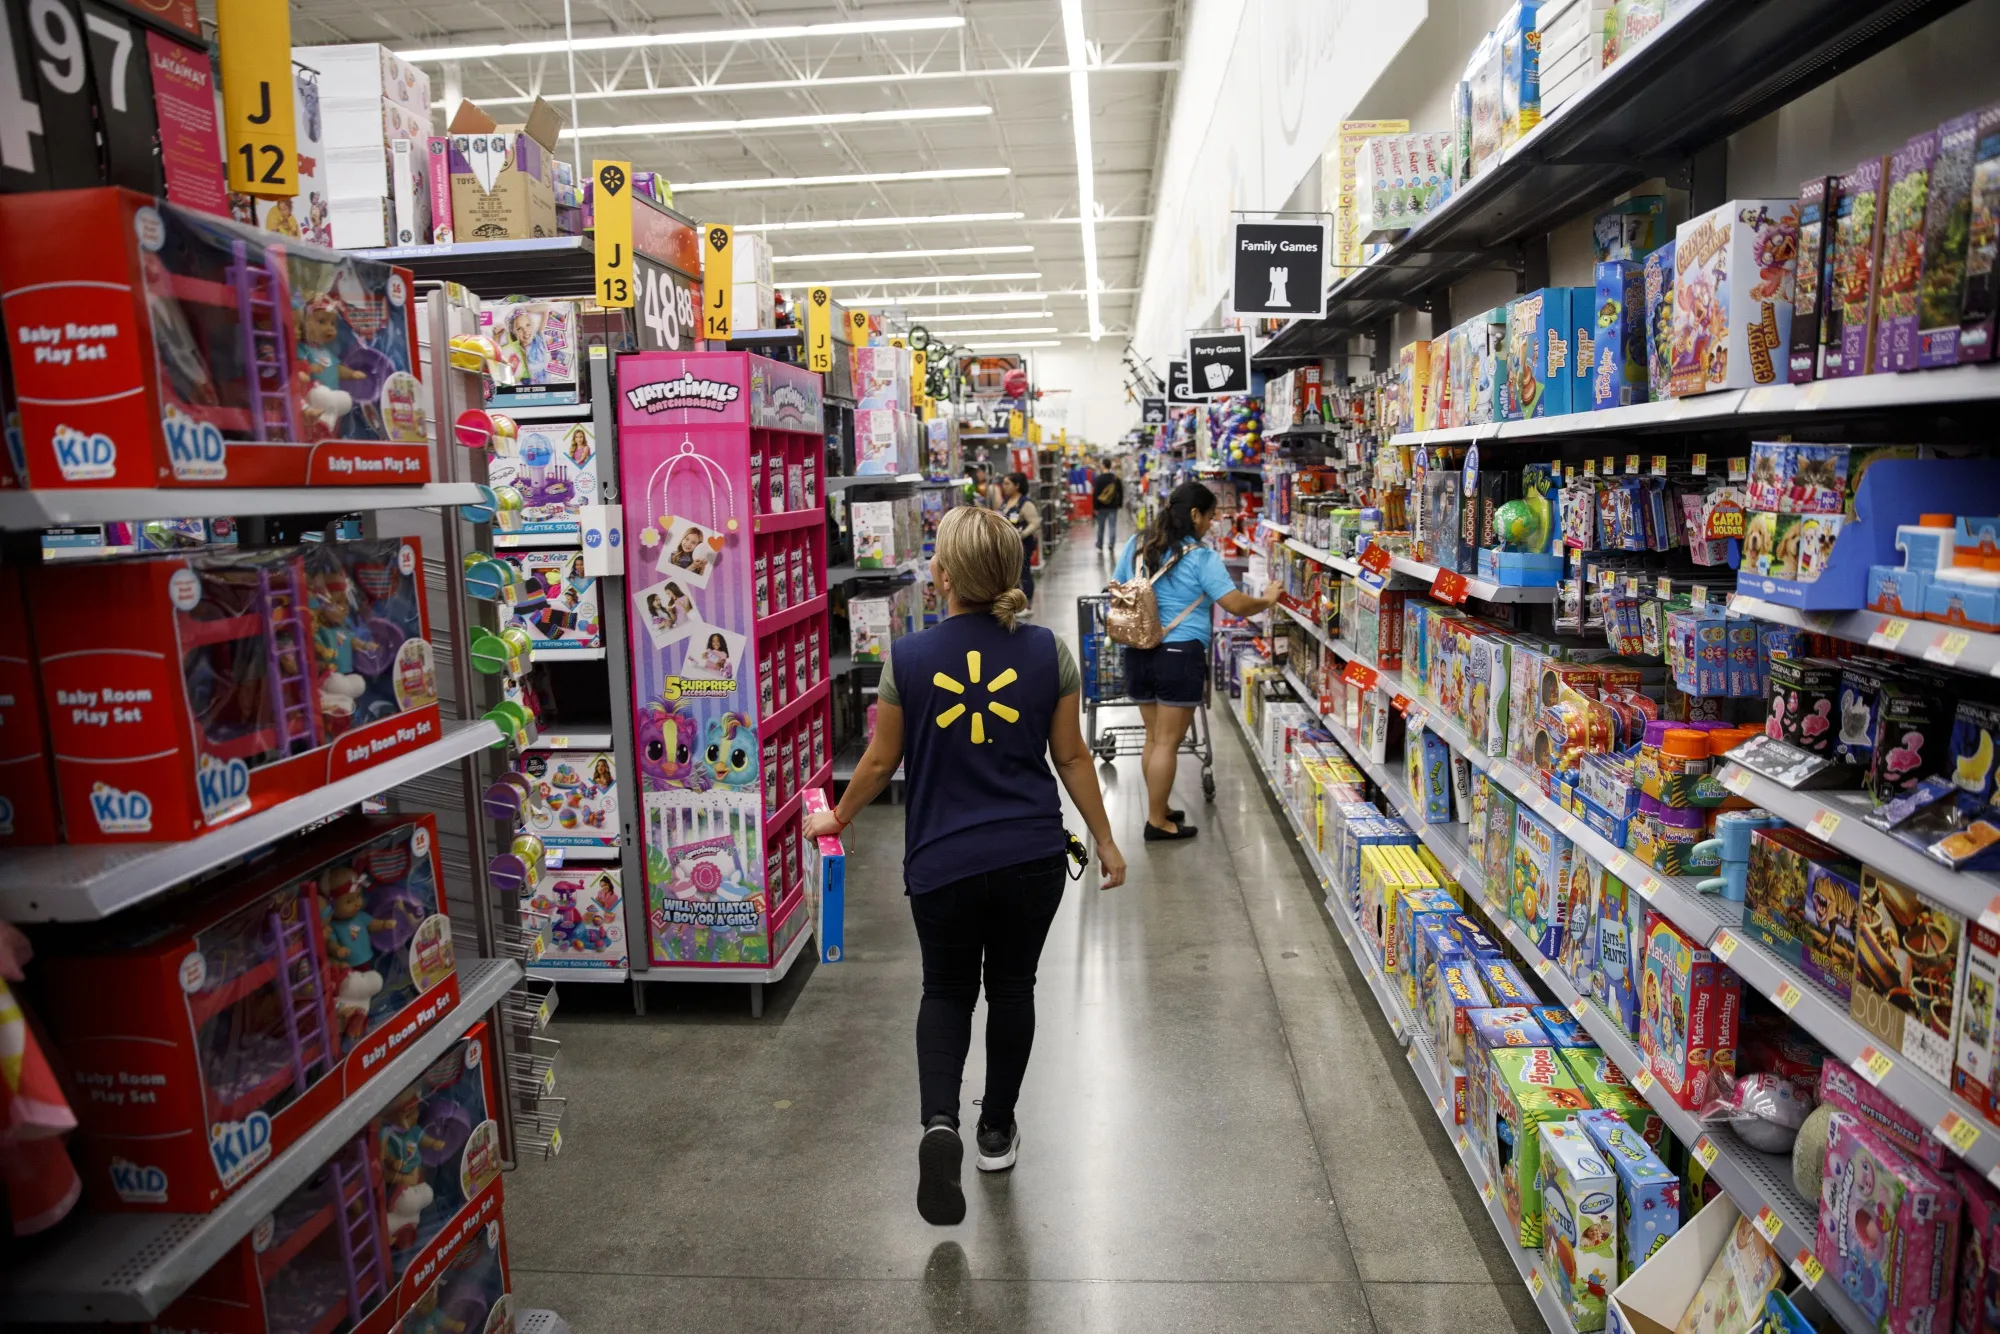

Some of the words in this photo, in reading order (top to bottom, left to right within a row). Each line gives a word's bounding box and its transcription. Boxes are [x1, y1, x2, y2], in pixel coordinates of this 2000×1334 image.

[248, 81, 271, 125] J
[239, 143, 286, 185] 12
[608, 243, 621, 268] J
[1241, 240, 1277, 254] Family
[1279, 240, 1318, 252] Games
[603, 278, 627, 301] 13
[713, 289, 724, 309] J
[19, 325, 60, 345] Baby
[65, 323, 118, 341] Room
[708, 316, 729, 335] 14
[817, 334, 824, 348] J
[1195, 346, 1215, 356] Party
[1216, 345, 1241, 354] Games
[35, 346, 70, 366] Play
[76, 344, 107, 360] Set
[813, 354, 828, 368] 15
[167, 420, 223, 463] KID
[58, 442, 111, 466] KID
[328, 456, 353, 474] Baby
[354, 456, 382, 471] Room
[383, 456, 403, 474] Play
[404, 456, 421, 471] Set
[1466, 500, 1475, 545] MONOPOLY
[1485, 500, 1493, 545] MONOPOLY
[1712, 512, 1743, 526] CARD
[1714, 525, 1743, 535] HOLDER
[1567, 672, 1584, 682] Spot
[1585, 672, 1596, 681] it!
[1610, 672, 1628, 682] Spot
[1629, 672, 1640, 681] it!
[1771, 663, 1791, 677] ORIGINAL
[1791, 668, 1801, 678] 3D
[57, 689, 99, 707] Baby
[103, 688, 152, 704] Room
[664, 674, 681, 700] 5
[680, 679, 737, 694] SURPRISE
[73, 708, 109, 726] Play
[114, 706, 142, 722] Set
[346, 744, 370, 763] Baby
[370, 734, 397, 752] Room
[397, 726, 417, 746] Play
[417, 719, 432, 735] Set
[200, 762, 248, 802] KID
[1456, 766, 1470, 799] TROUBLE
[94, 794, 150, 820] KID
[663, 898, 691, 913] WILL
[691, 900, 714, 914] YOU
[715, 901, 756, 914] HATCH
[663, 911, 672, 922] A
[672, 912, 697, 925] BOY
[698, 913, 714, 925] OR
[726, 912, 759, 927] GIRL?
[1752, 912, 1769, 929] DINO
[1770, 921, 1793, 945] GLOW
[1386, 924, 1396, 967] OPERATION
[1601, 928, 1619, 946] ANTS
[1762, 931, 1773, 945] 100
[1977, 930, 1997, 949] 550
[1602, 944, 1627, 965] PANTS
[1646, 935, 1687, 992] Matching
[1810, 948, 1832, 969] DINO
[1824, 973, 1836, 986] 100
[1692, 992, 1709, 1046] Matching
[1719, 993, 1735, 1046] Matching
[362, 1042, 387, 1070] Baby
[388, 1024, 416, 1051] Room
[415, 1009, 438, 1035] Play
[434, 993, 451, 1015] Set
[1529, 1049, 1553, 1085] Hippos
[1860, 1103, 1893, 1125] MYSTERY
[1892, 1122, 1921, 1144] PUZZLE
[212, 1114, 269, 1175] KID
[1582, 1197, 1611, 1210] COOTIE
[1917, 1198, 1930, 1216] 48
[414, 1263, 438, 1287] Baby
[437, 1241, 462, 1269] Room
[461, 1215, 483, 1245] Play
[479, 1194, 495, 1218] Set
